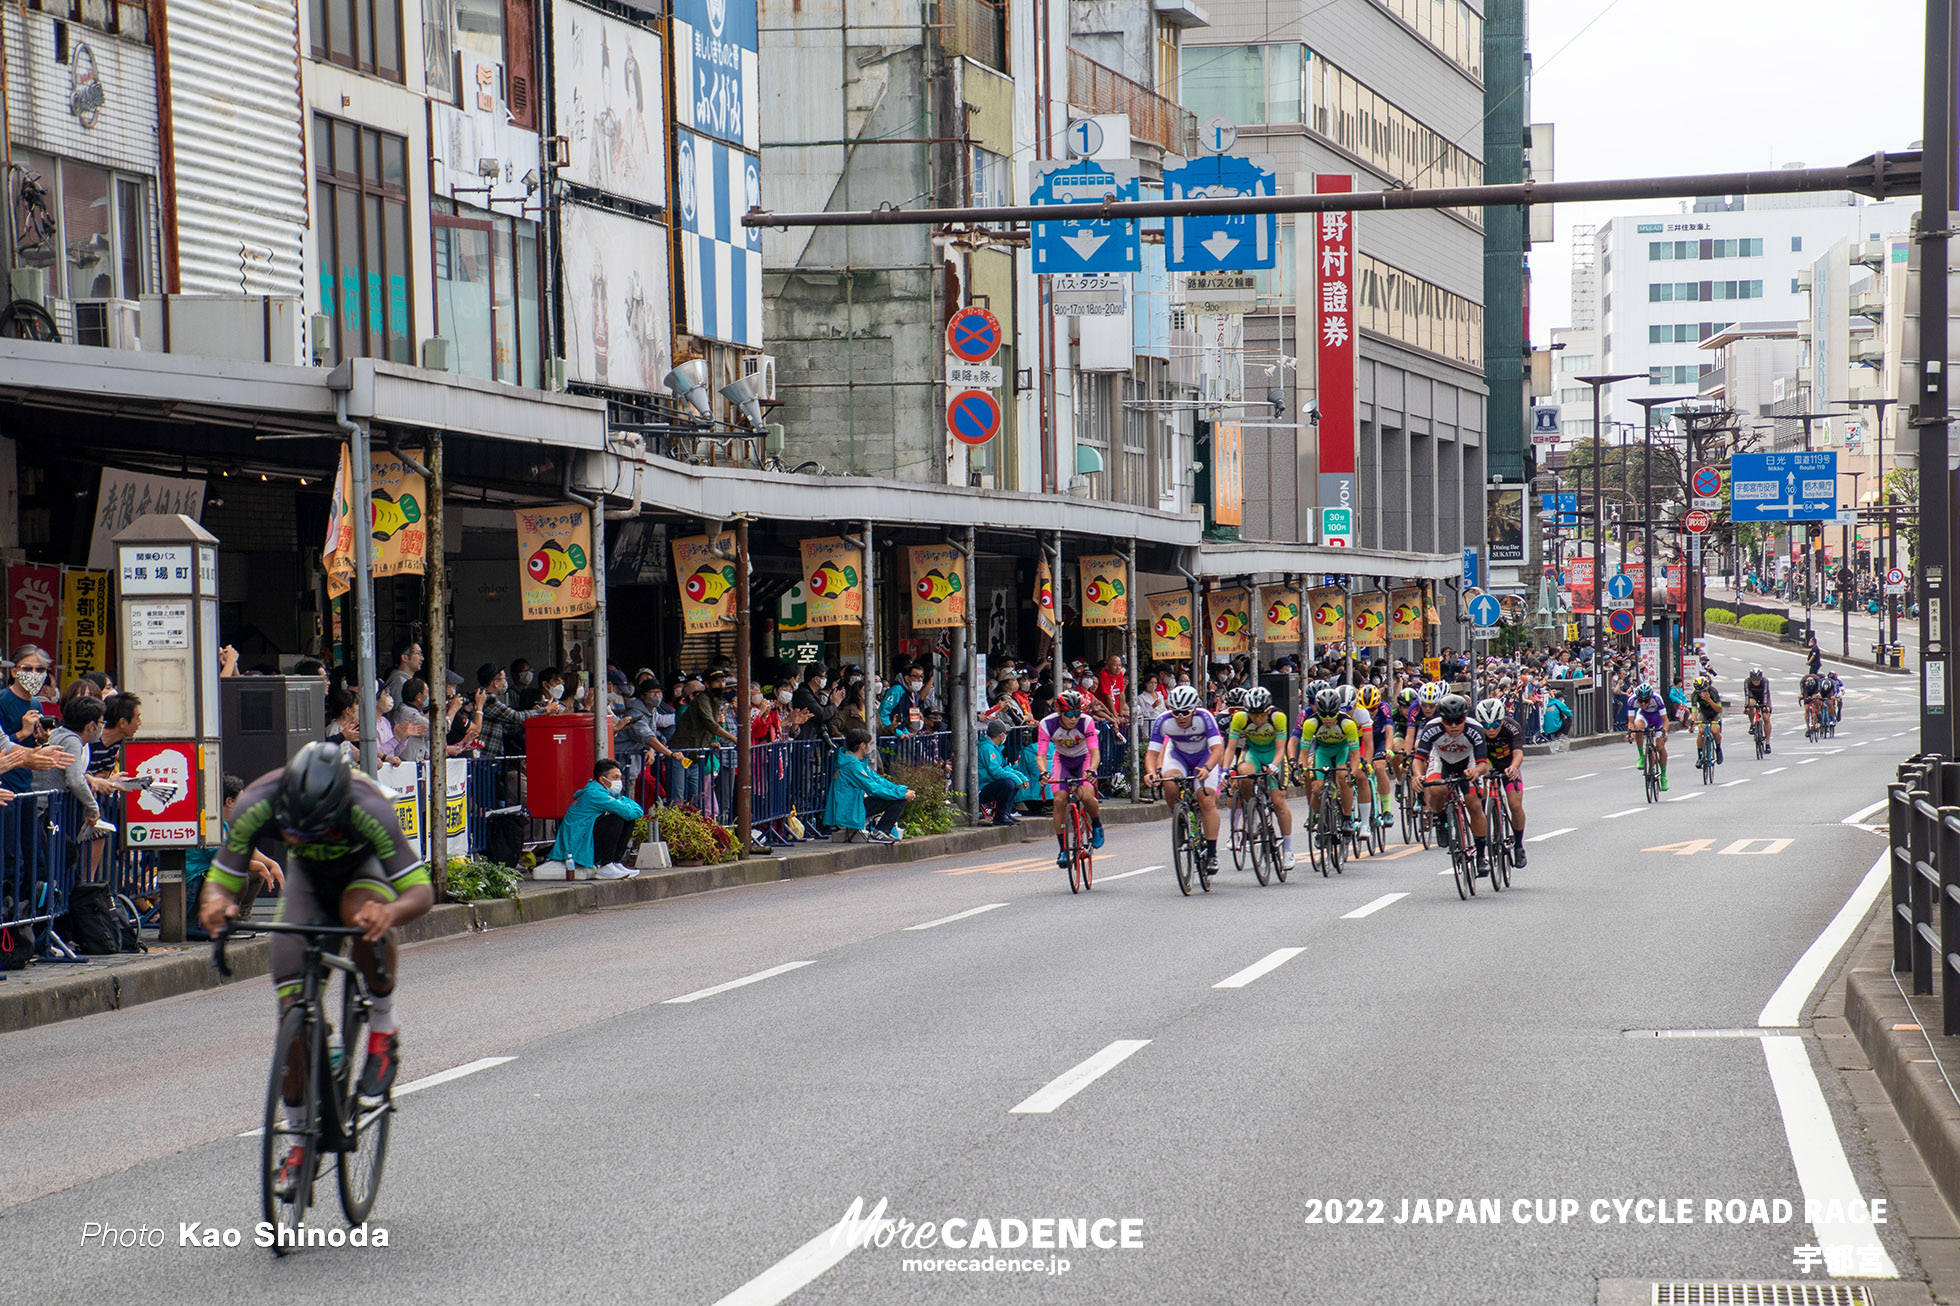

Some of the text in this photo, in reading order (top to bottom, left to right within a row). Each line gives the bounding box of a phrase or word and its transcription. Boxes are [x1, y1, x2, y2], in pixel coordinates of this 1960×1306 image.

[697, 66, 741, 136] ふくがみ
[1077, 123, 1088, 153] 1
[1322, 211, 1349, 347] 野村證券
[1818, 271, 1826, 332] HOTEL
[951, 370, 997, 382] 乗降を除く
[1766, 455, 1830, 465] 日光 国道119号
[134, 566, 188, 580] 馬場町
[74, 576, 96, 678] 宇都宮餃子
[797, 642, 819, 664] 空
[150, 828, 196, 840] たいらや
